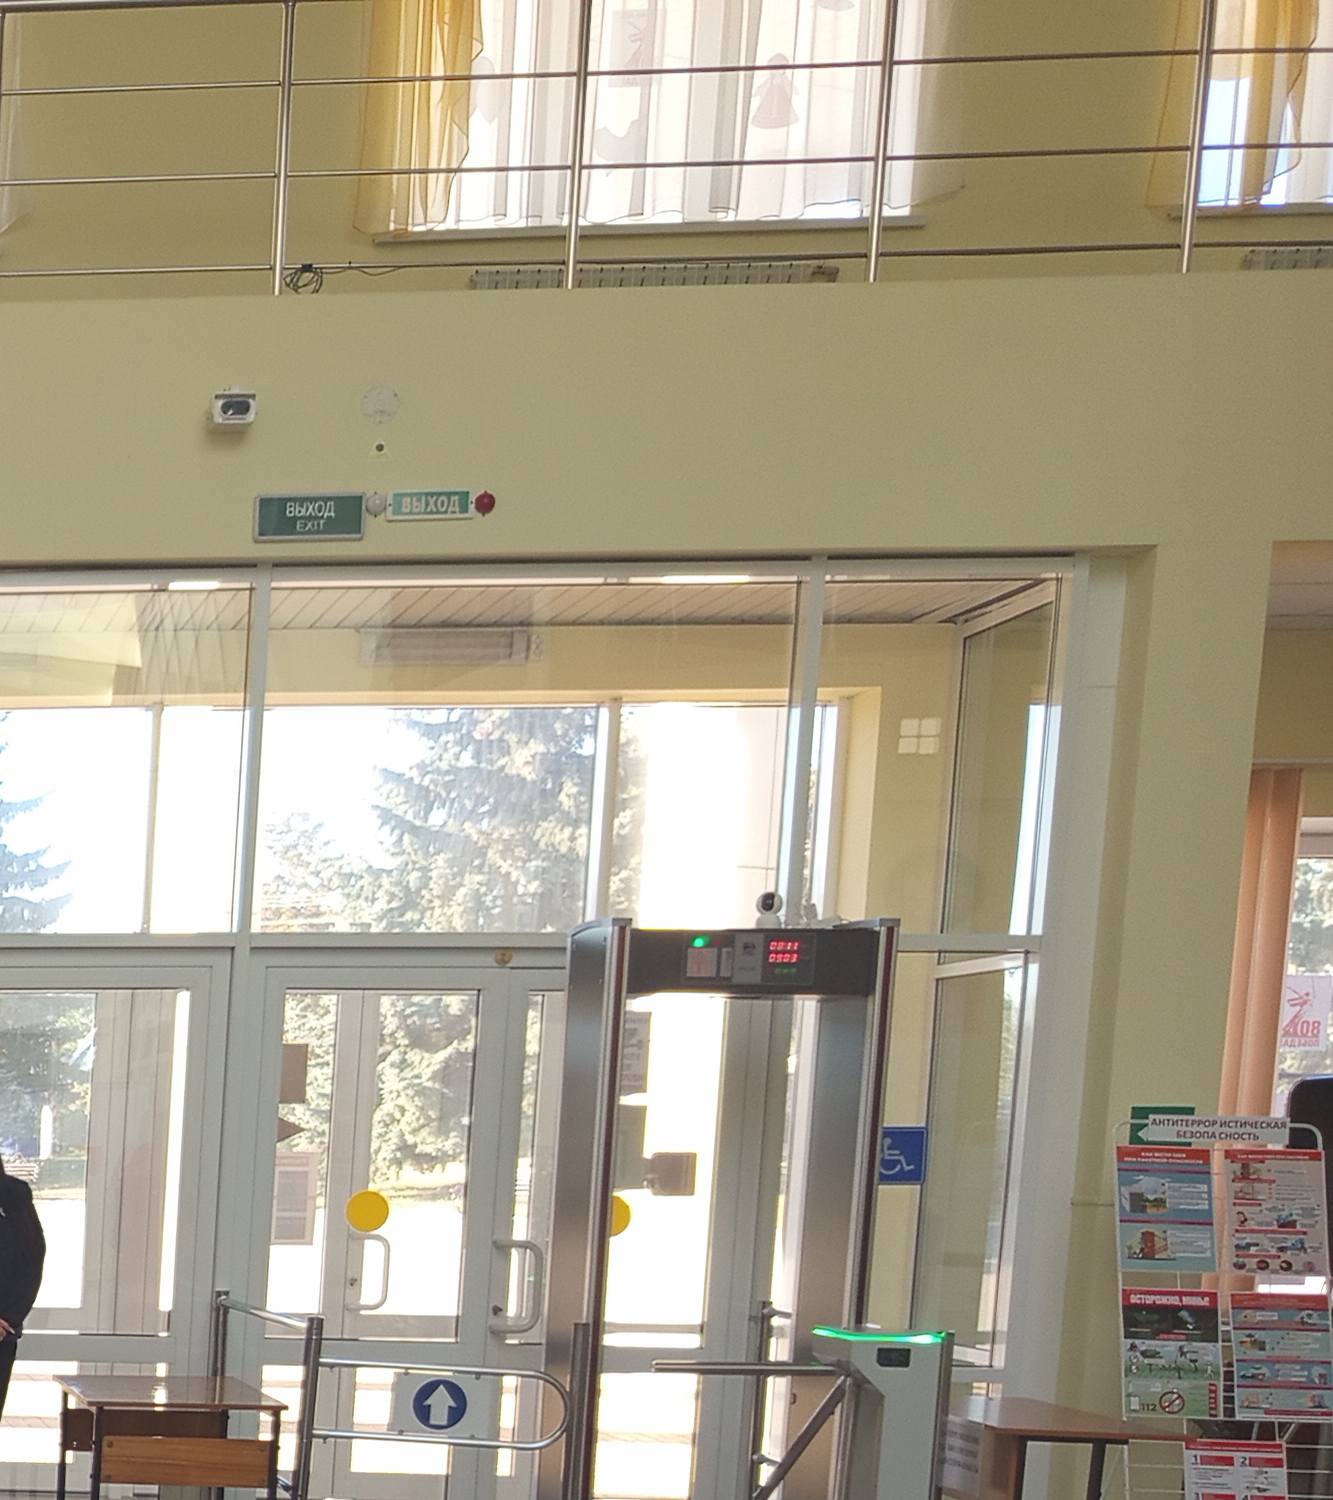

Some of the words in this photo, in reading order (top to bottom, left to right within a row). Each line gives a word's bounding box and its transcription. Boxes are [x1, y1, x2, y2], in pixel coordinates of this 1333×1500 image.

[285, 500, 335, 518] ВЫХОД
[401, 495, 460, 515] ВЫХОД
[296, 519, 326, 532] EXIT
[1140, 1402, 1157, 1413] 112
